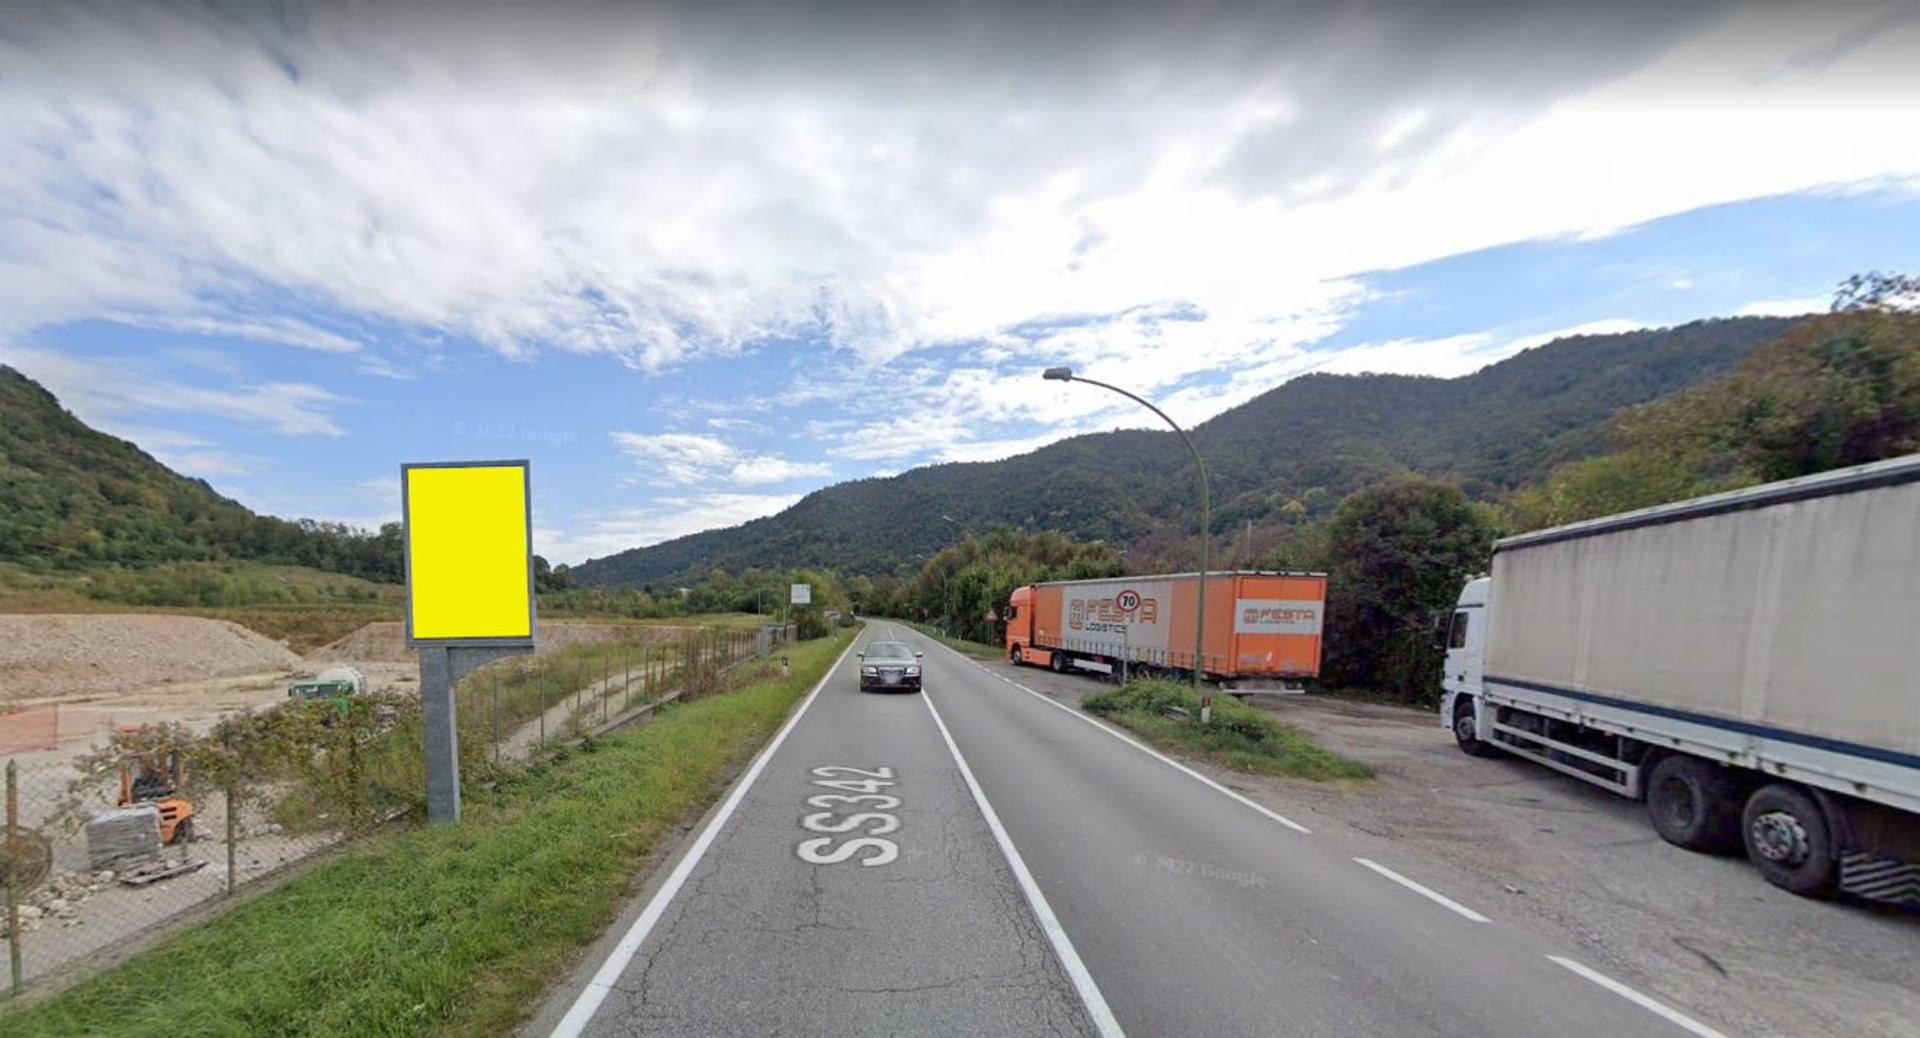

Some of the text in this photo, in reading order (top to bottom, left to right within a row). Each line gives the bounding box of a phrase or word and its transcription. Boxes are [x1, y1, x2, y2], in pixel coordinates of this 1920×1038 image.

[1122, 596, 1135, 607] 70
[1260, 607, 1316, 620] FESTA
[798, 766, 901, 867] SS342
